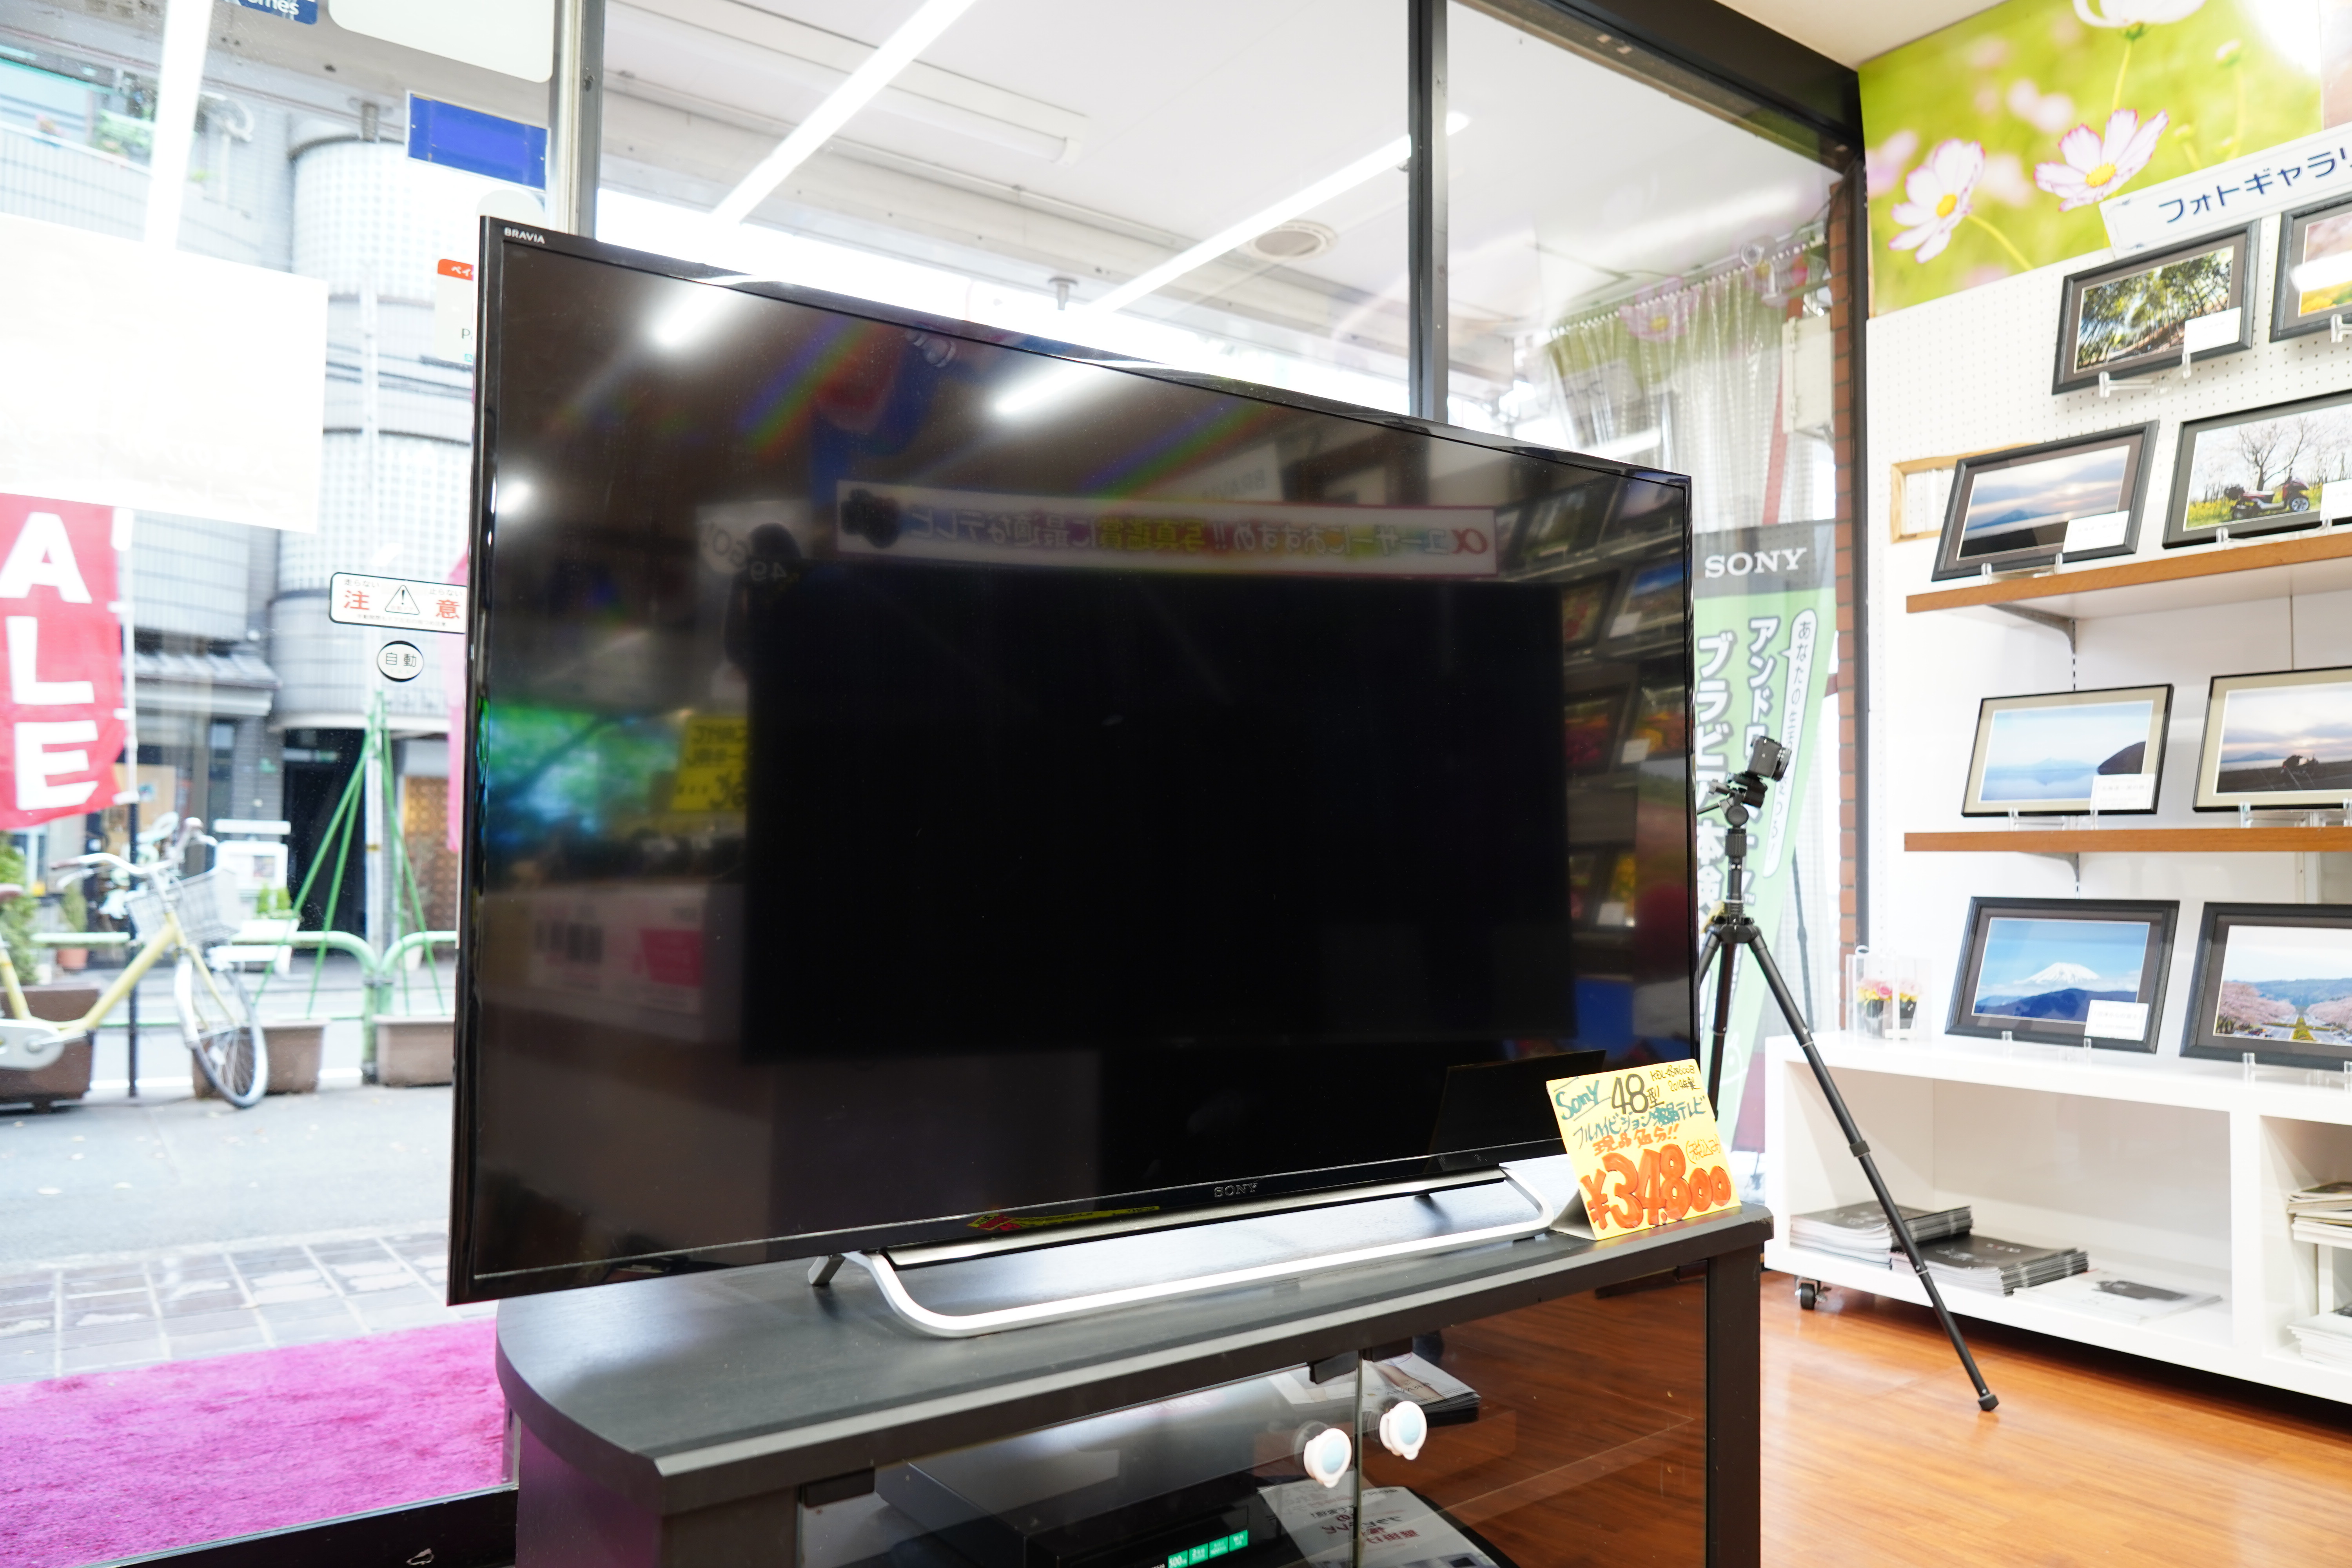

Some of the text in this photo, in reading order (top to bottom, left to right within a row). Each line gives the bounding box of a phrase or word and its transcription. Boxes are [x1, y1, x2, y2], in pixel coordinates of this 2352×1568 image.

[505, 227, 545, 245] BRAVIA
[1704, 547, 1807, 579] SONY
[385, 652, 417, 668] 自動
[1214, 1182, 1258, 1198] SONY
